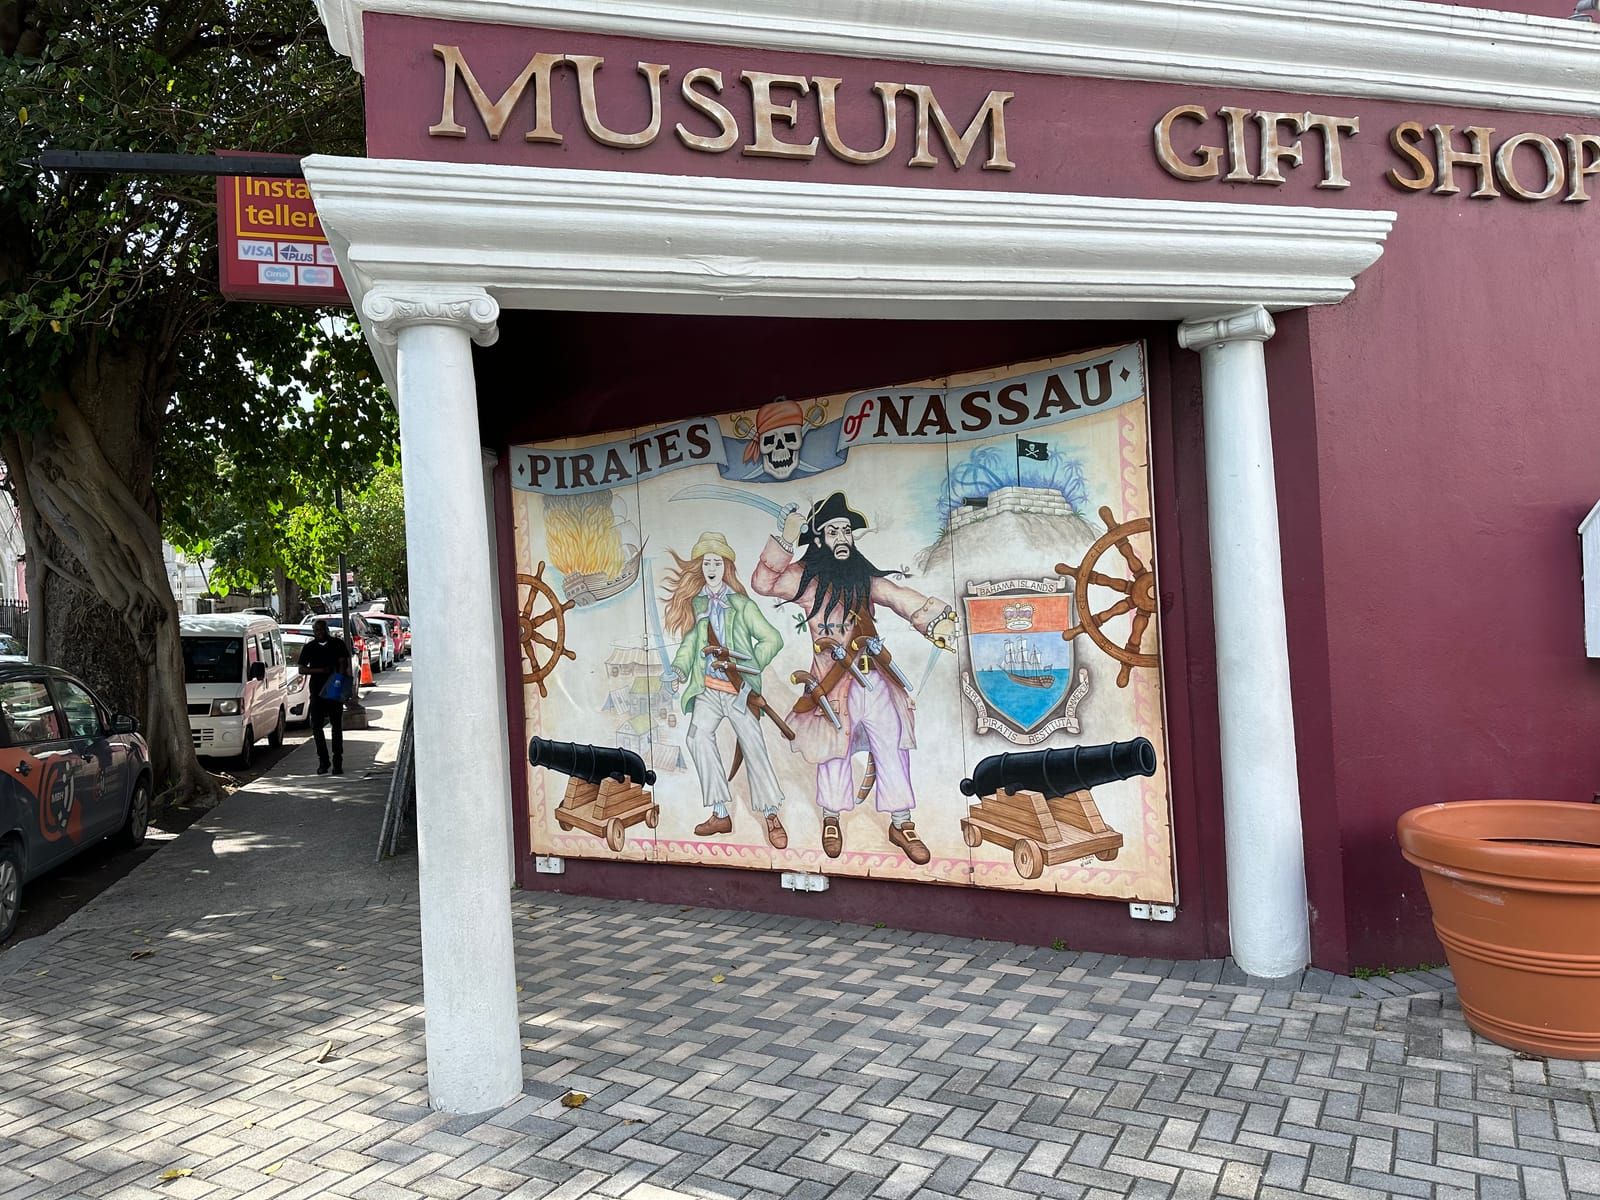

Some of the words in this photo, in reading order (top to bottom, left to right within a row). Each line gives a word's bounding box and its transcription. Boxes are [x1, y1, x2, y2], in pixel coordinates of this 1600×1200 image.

[428, 43, 1015, 171] MUSEUM
[1153, 104, 1360, 189] GIFT
[1385, 120, 1600, 203] SHOP
[245, 204, 317, 228] teller
[242, 245, 273, 257] VISA
[289, 253, 313, 262] PLUS
[527, 423, 712, 490] PIRATES
[843, 399, 874, 443] of
[873, 359, 1114, 438] NASSAU
[980, 581, 1015, 596] BAHAMA
[1017, 580, 1055, 593] ISLANDS
[982, 718, 1018, 741] PIRATIS
[1028, 719, 1073, 744] RESTITUTA
